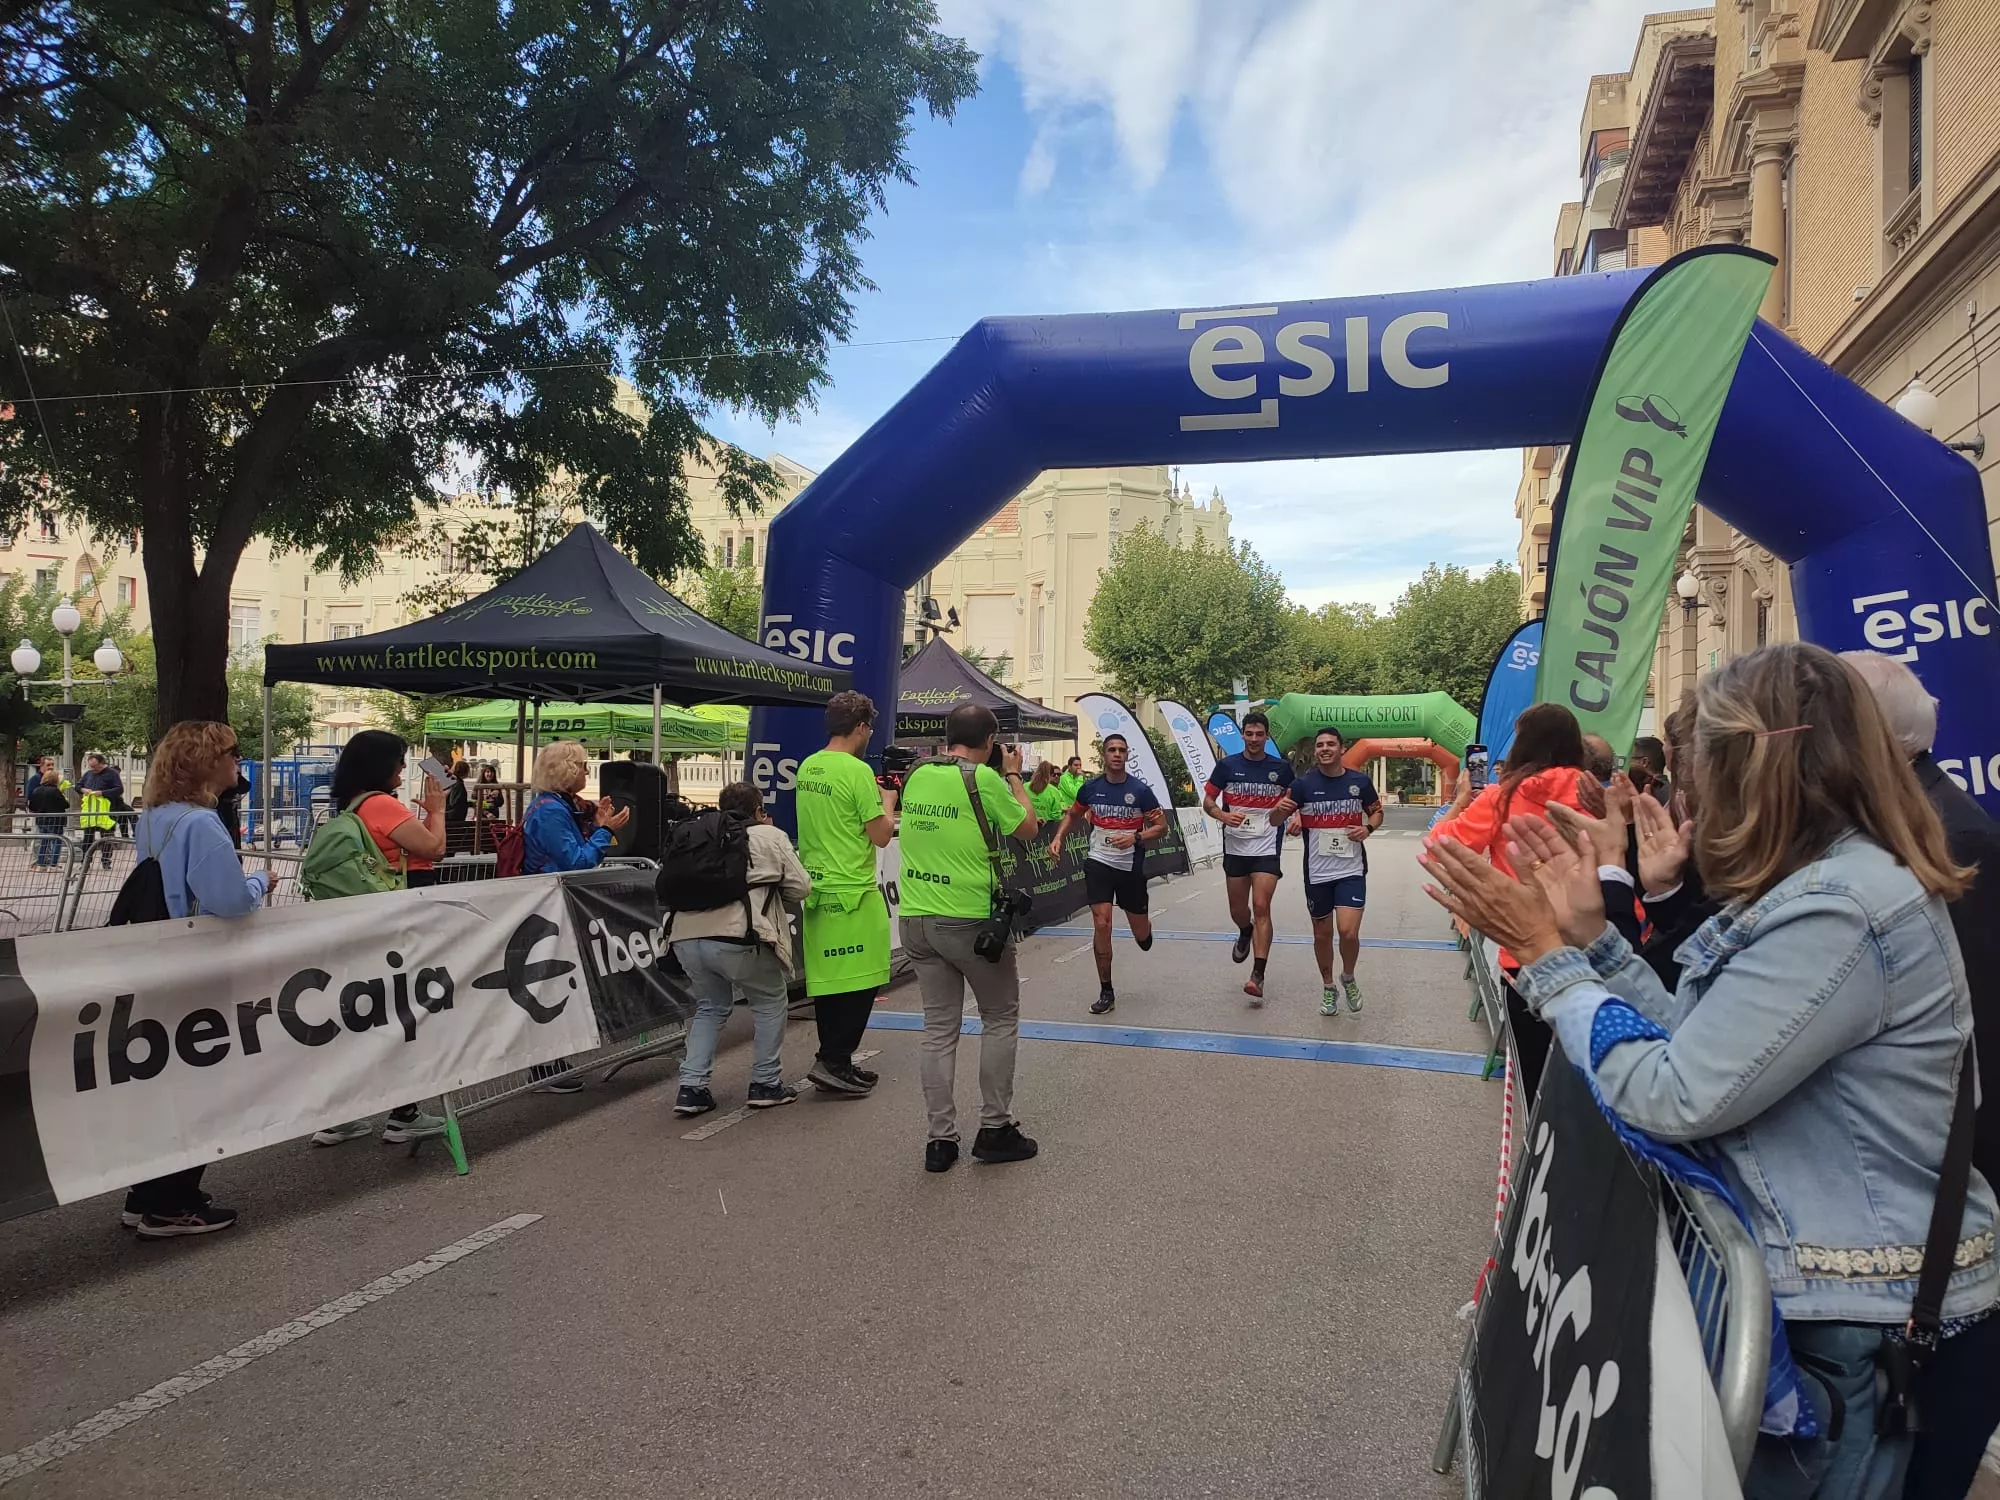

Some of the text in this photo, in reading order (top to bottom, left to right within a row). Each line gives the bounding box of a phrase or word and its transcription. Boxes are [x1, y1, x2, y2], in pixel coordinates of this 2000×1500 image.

[1570, 447, 1664, 714] CAJÓN VIP
[317, 642, 598, 677] www.fartlecksport.com
[694, 655, 833, 692] www.fartlecksport.com
[1310, 705, 1419, 723] FARTLECK SPORT
[1243, 818, 1251, 826] 4
[1331, 838, 1340, 847] 5
[72, 950, 455, 1093] iberCaja
